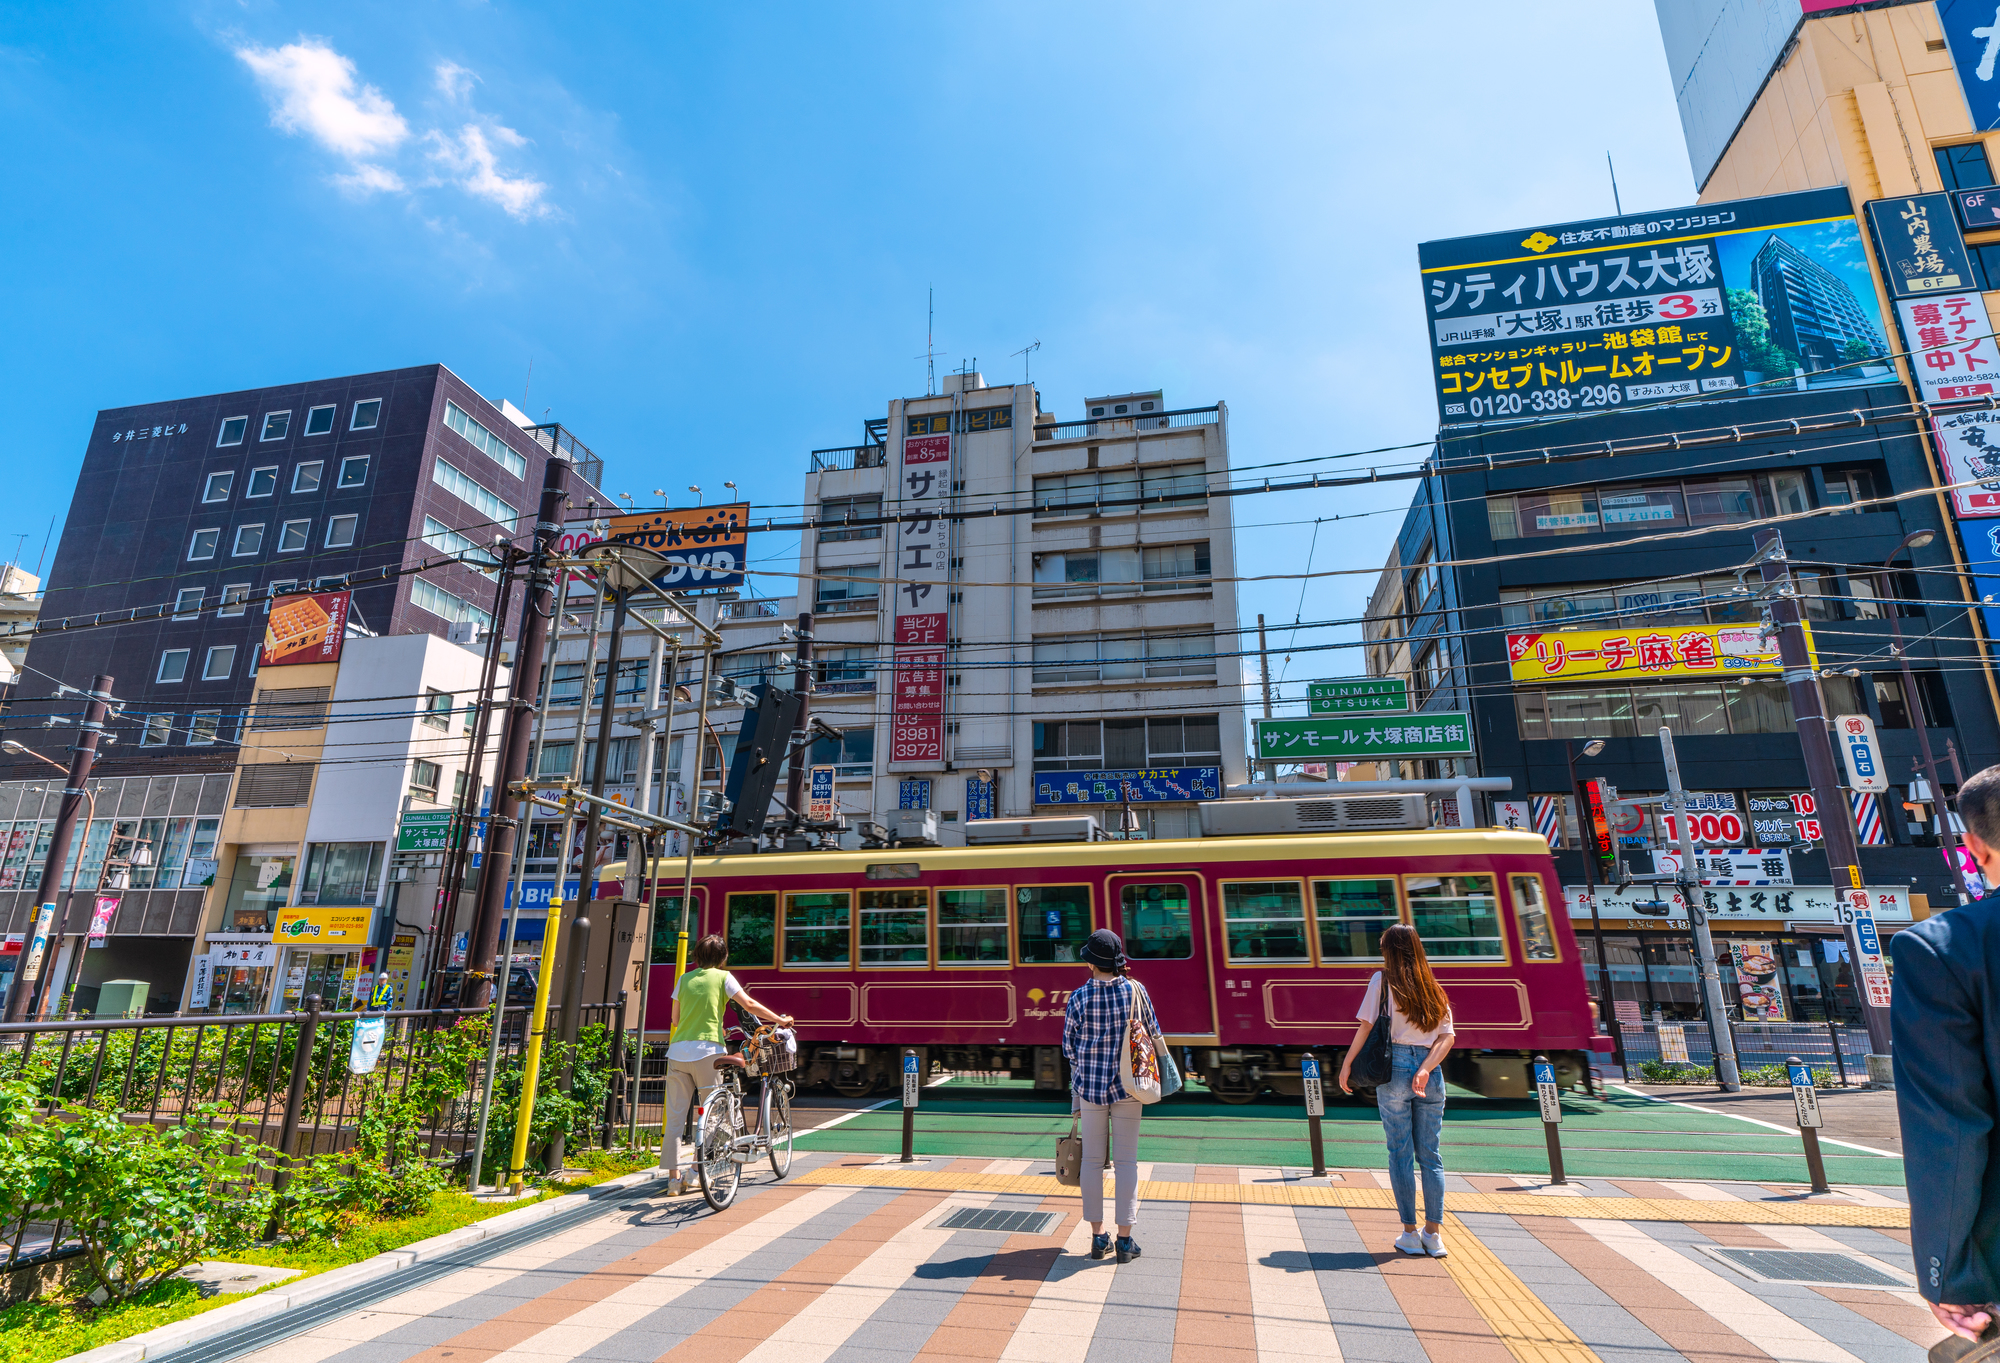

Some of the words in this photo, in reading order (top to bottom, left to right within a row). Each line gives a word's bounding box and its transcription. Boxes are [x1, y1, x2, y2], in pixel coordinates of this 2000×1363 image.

[1965, 195, 1986, 208] 6F
[1559, 211, 1737, 245] 住友不動産のマンション
[1900, 200, 1945, 274] 山内農場
[1430, 244, 1716, 313] シティハウス大塚
[1910, 303, 1956, 372] 募集中
[1943, 297, 1989, 372] テナント
[1441, 344, 1732, 394] コンセプトルームオープン
[1708, 378, 1727, 389] 検索
[1469, 383, 1622, 417] 0120-338-296
[112, 423, 189, 443] 今井三菱ビル
[907, 438, 948, 449] おかげさまで
[935, 469, 948, 571] 縁起物ともちゃの店
[1604, 510, 1673, 523] kizuna
[902, 470, 936, 608] サカエヤ
[663, 551, 736, 584] DVD
[902, 615, 940, 630] 当ビル
[1510, 637, 1531, 658] 3F
[1535, 631, 1718, 675] リーチ麻雀
[898, 670, 939, 683] 広告主
[905, 685, 931, 698] 募集
[897, 701, 940, 710] お問い合わせは
[1321, 697, 1394, 709] OTSUKA
[896, 727, 937, 741] 3981
[896, 743, 939, 757] 3972
[1855, 748, 1871, 772] 白石
[1200, 768, 1215, 778] 2F
[1093, 782, 1117, 801] 麻雀
[1191, 779, 1216, 798] 財布
[1750, 799, 1789, 812] カットのみ
[405, 828, 446, 838] サンモール
[1754, 820, 1792, 833] シルバー
[1879, 894, 1897, 904] 24
[1834, 903, 1854, 924] 15
[1861, 924, 1877, 949] 白石
